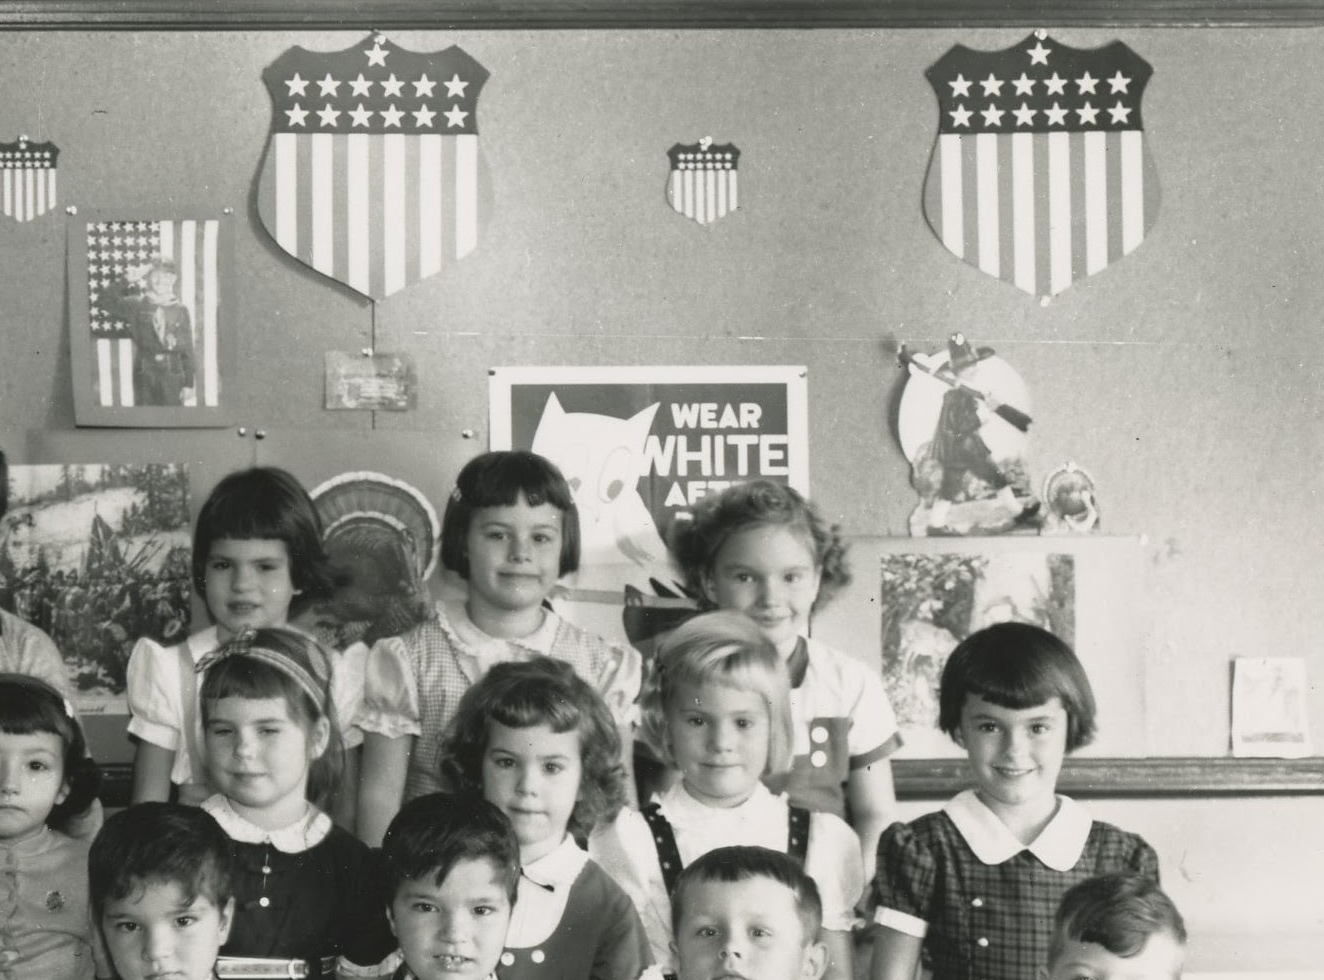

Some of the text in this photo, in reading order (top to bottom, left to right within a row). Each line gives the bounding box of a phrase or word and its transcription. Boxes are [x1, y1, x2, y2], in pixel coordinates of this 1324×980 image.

[671, 402, 762, 429] WEAR
[639, 434, 789, 477] WHITE
[664, 480, 748, 507] AFT
